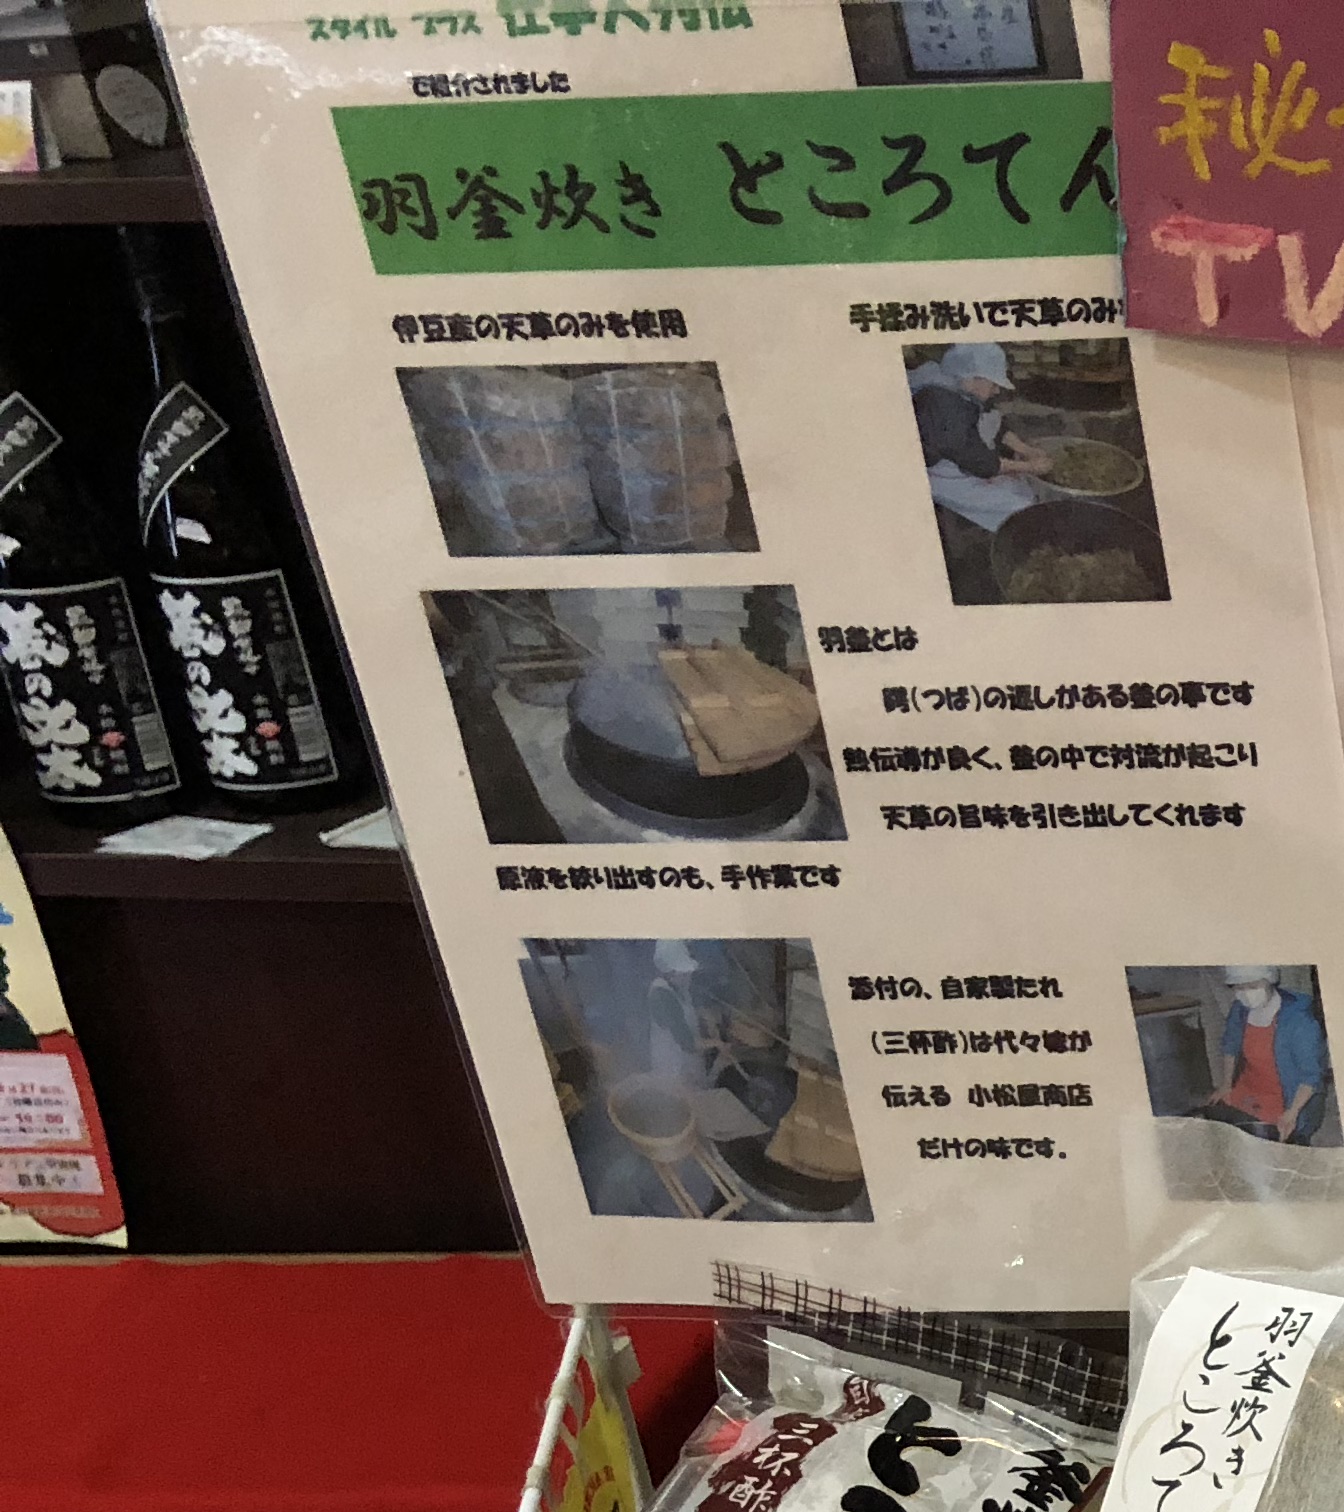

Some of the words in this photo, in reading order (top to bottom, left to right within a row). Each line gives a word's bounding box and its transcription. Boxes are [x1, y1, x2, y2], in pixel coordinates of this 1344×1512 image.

[361, 160, 663, 240] 羽釜炊き
[392, 309, 688, 344] 伊豆産の天草のみを使用
[850, 296, 1125, 334] 手揉み洗いで天草のみ
[818, 625, 919, 653] 羽釜とは
[968, 1082, 1094, 1108] 小松屋商店
[1213, 1305, 1314, 1490] 羽釜炊き
